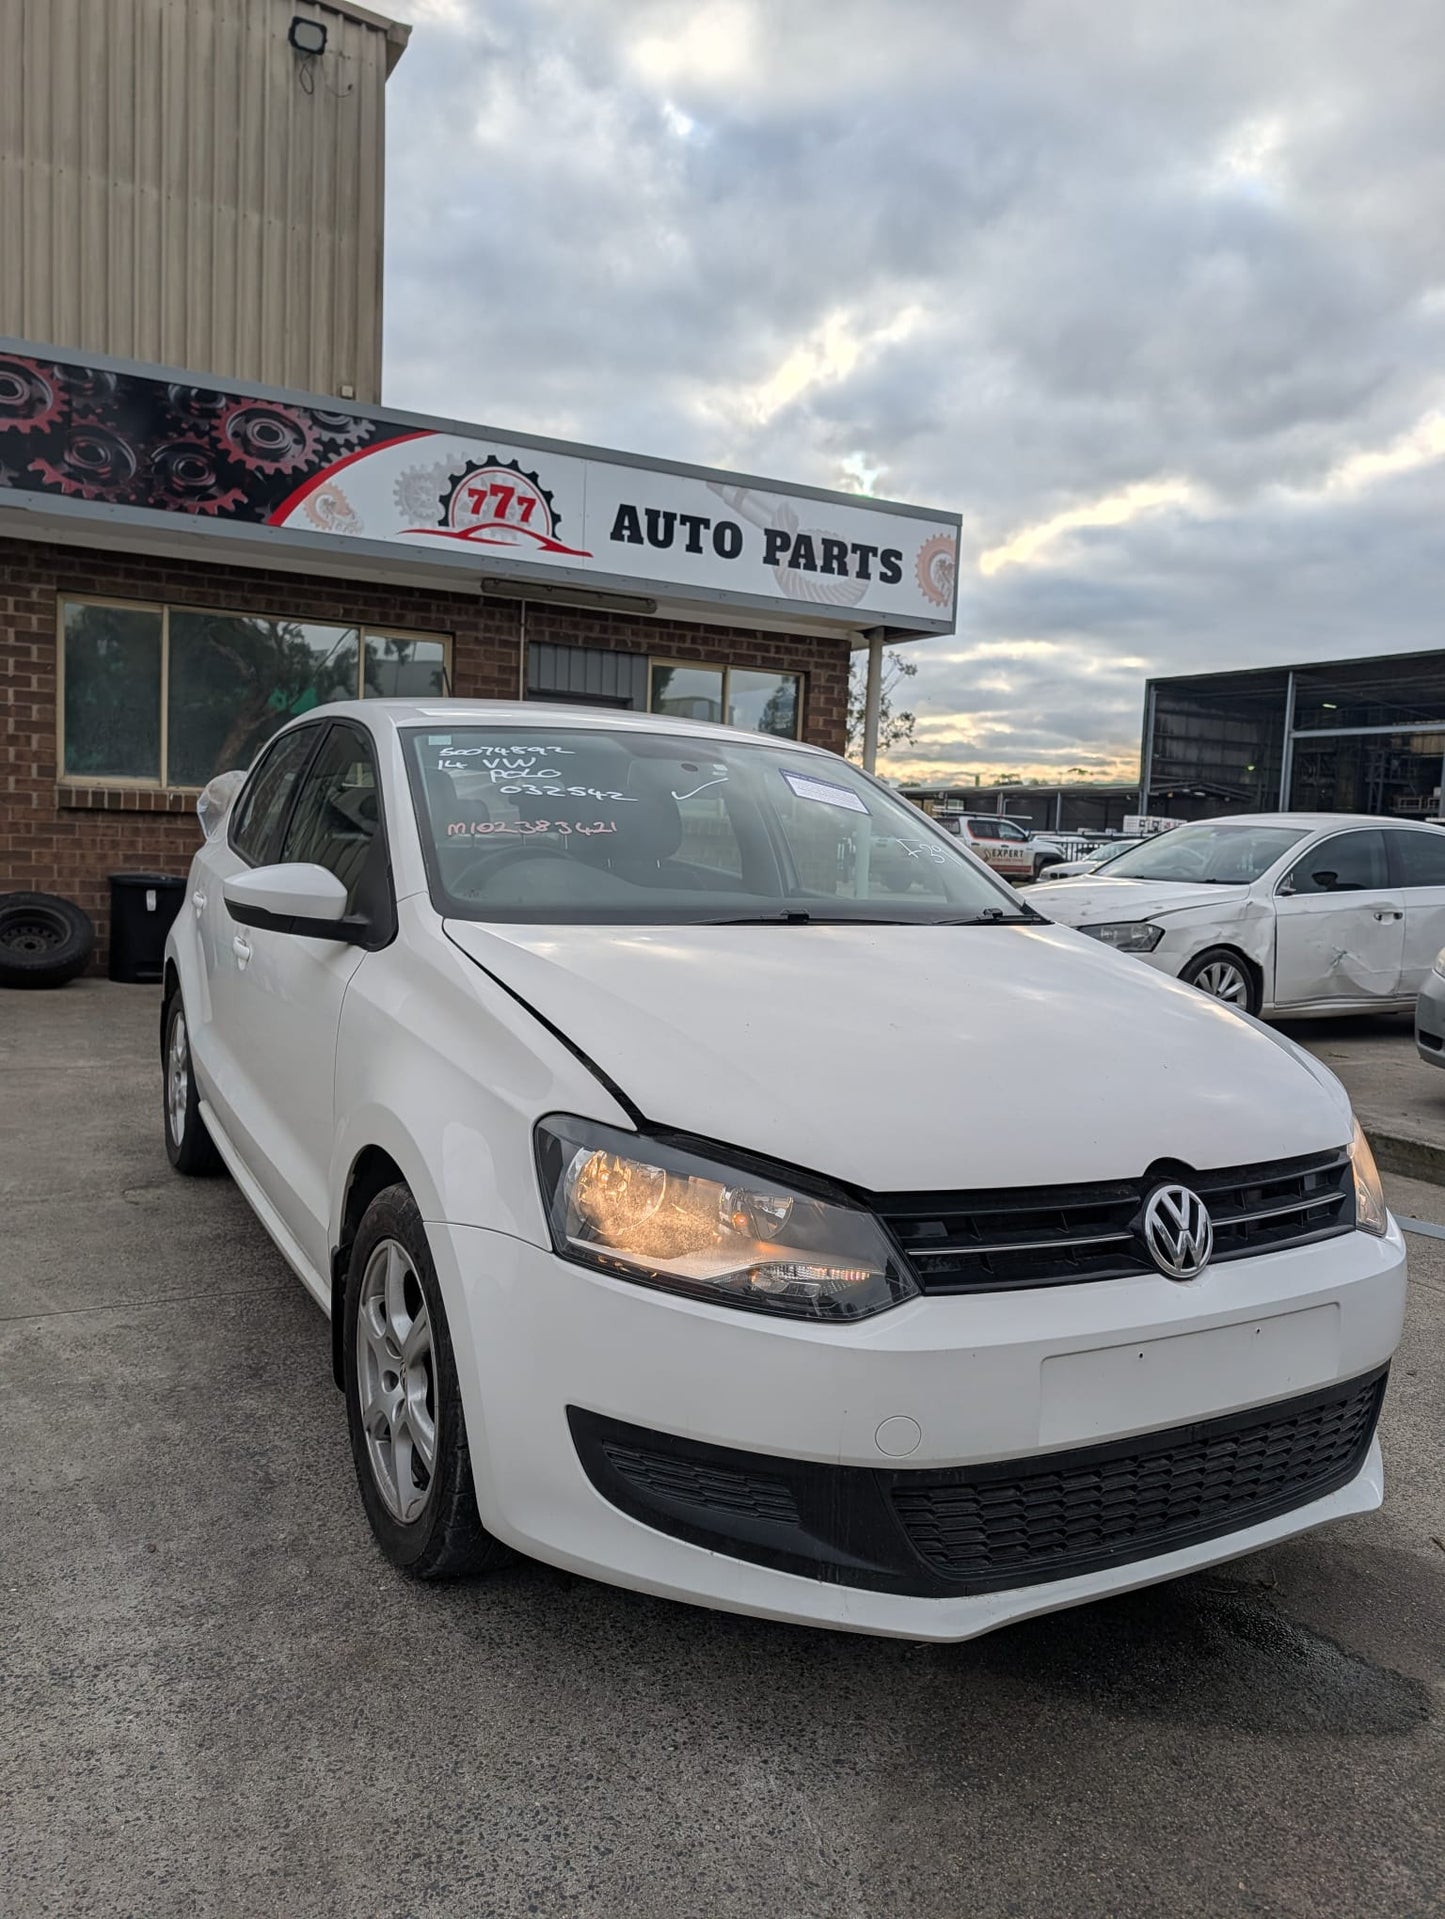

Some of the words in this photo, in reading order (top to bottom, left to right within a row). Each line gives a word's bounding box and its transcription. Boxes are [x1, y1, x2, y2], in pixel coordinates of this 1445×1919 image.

[467, 483, 537, 523] 777
[610, 503, 743, 559] AUTO
[762, 528, 903, 584] PARTS
[438, 759, 468, 770] 14
[482, 757, 536, 768] VW
[489, 768, 561, 783] POLO
[500, 784, 638, 801] 032542
[992, 849, 1024, 858] EXPERT
